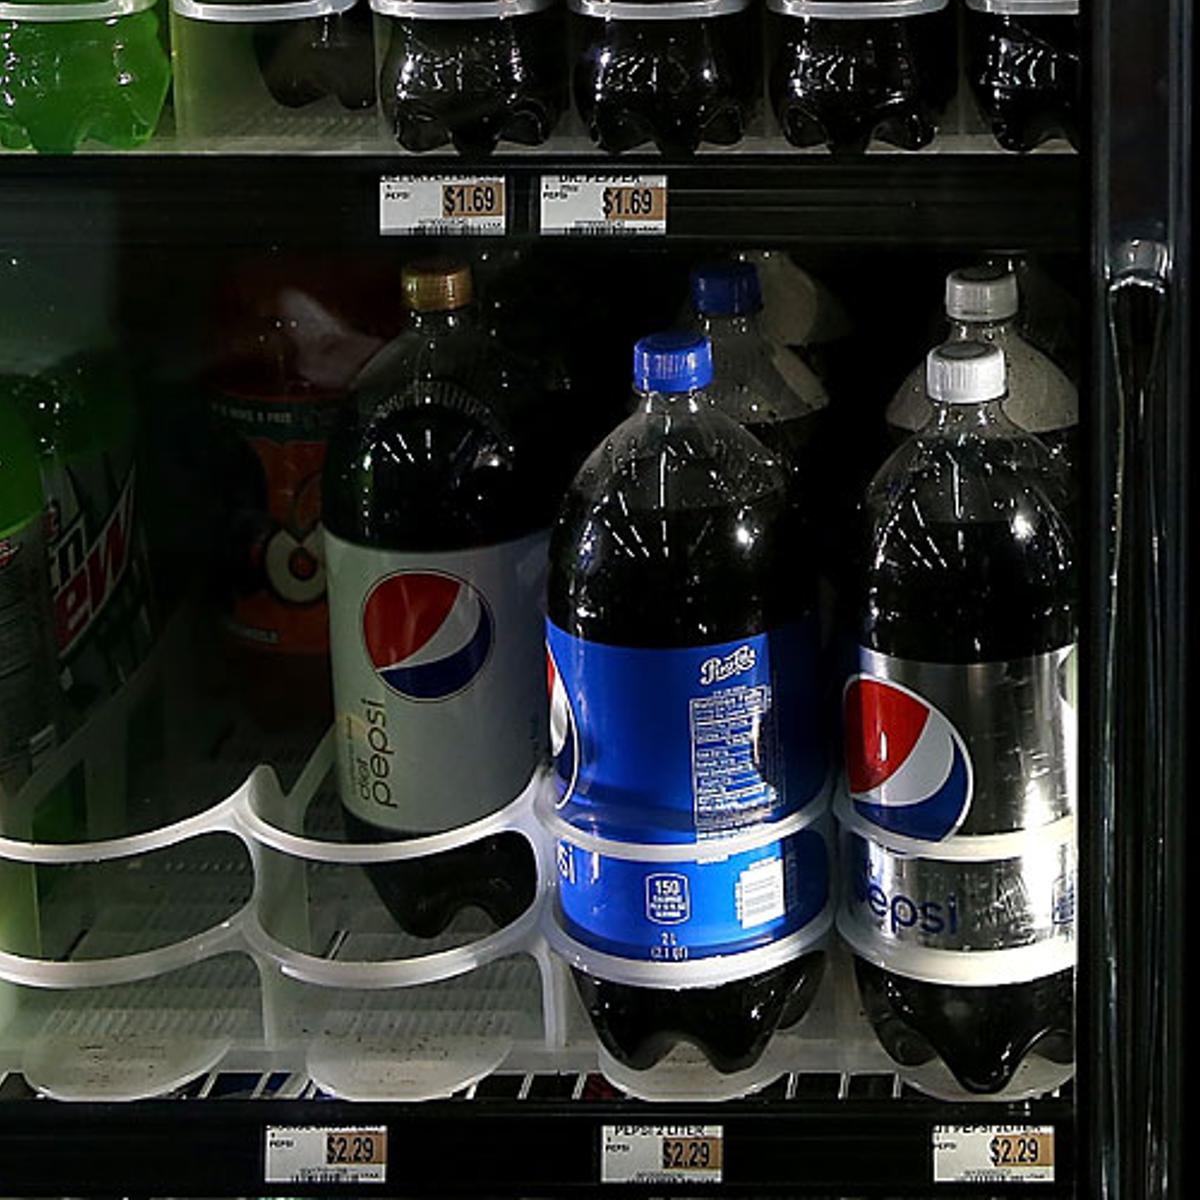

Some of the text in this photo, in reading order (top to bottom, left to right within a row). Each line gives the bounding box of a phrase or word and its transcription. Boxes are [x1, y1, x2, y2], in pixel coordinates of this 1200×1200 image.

[443, 186, 495, 215] $1.69
[603, 187, 652, 219] $1.69
[360, 697, 398, 809] pepsi
[655, 880, 680, 895] 150
[866, 884, 958, 934] epsi
[327, 1136, 373, 1164] $2.29
[663, 1141, 709, 1169] $2.29
[989, 1138, 1037, 1166] $2.29
